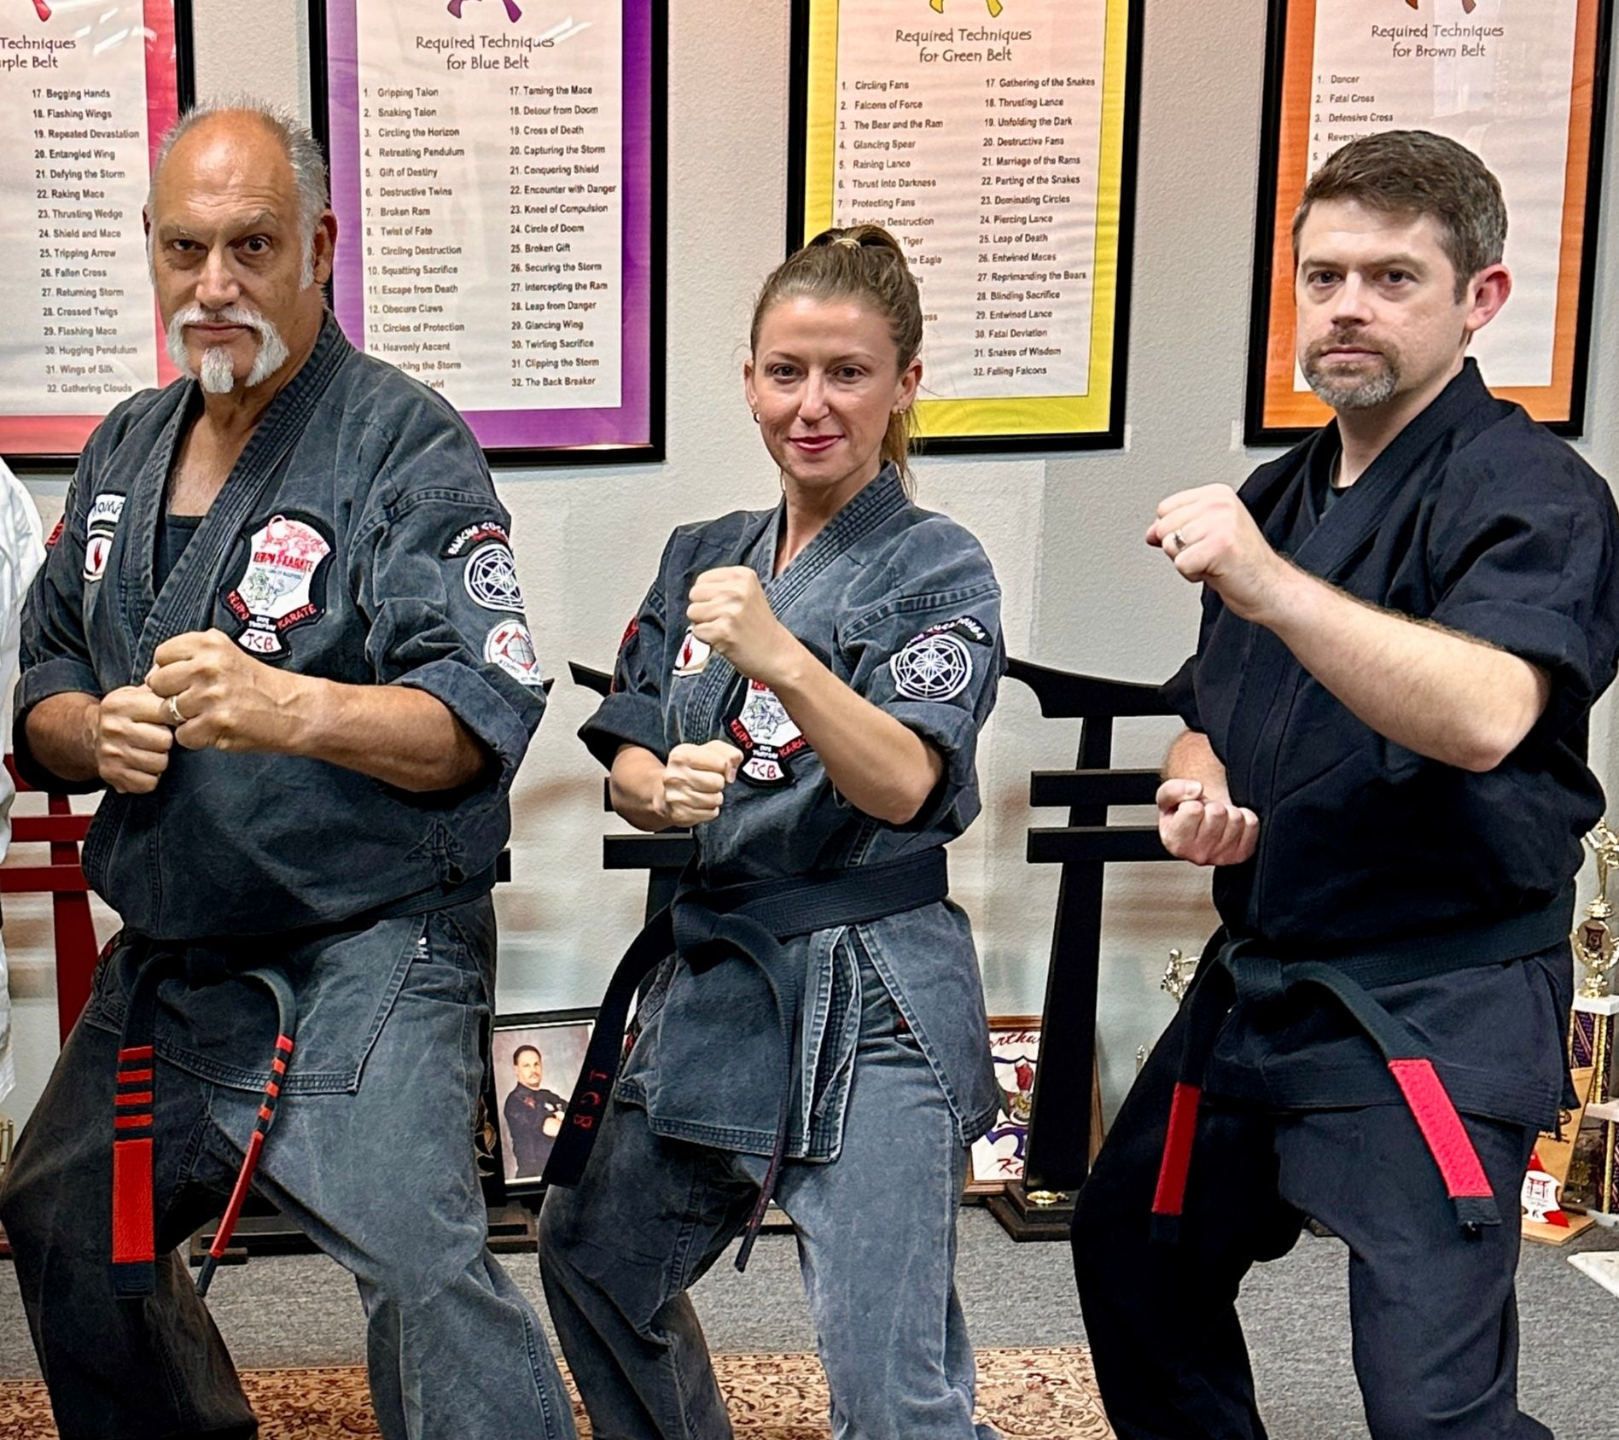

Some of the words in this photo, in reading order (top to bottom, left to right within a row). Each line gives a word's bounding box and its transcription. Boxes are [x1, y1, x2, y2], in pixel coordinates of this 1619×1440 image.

[896, 28, 954, 46] Required
[958, 26, 1032, 45] Techniques
[1371, 24, 1428, 40] Required
[1432, 23, 1504, 40] Techniques
[0, 35, 76, 52] Techniques
[416, 35, 475, 54] Required
[480, 34, 555, 51] Techniques
[919, 47, 938, 62] for
[942, 49, 982, 62] Green
[986, 47, 1012, 61] Belt
[1392, 42, 1411, 58] for
[1416, 44, 1456, 57] Brown
[1461, 42, 1486, 57] Belt
[32, 56, 58, 68] Belt
[446, 54, 467, 71] for
[471, 56, 500, 70] Blue
[503, 55, 530, 69] Belt
[999, 78, 1040, 89] Gathering
[1041, 78, 1050, 86] of
[1051, 78, 1064, 86] the
[1066, 77, 1095, 86] Snakes
[1331, 74, 1360, 84] Dancer
[523, 86, 554, 97] Taming
[556, 86, 569, 94] the
[571, 85, 592, 94] Mace
[855, 81, 887, 92] Circling
[889, 80, 909, 89] Fans
[46, 89, 82, 100] Begging
[84, 89, 111, 98] Hands
[1330, 94, 1350, 103] Fatal
[1351, 94, 1375, 102] Cross
[855, 100, 887, 109] Falcons
[889, 100, 898, 109] of
[899, 100, 923, 109] Force
[998, 98, 1038, 109] Thrusting
[1040, 98, 1064, 106] Lance
[47, 109, 84, 120] Flashing
[85, 109, 112, 120] Wings
[378, 108, 412, 119] Snaking
[414, 107, 437, 116] Talon
[524, 106, 552, 115] Detour
[553, 106, 572, 114] from
[574, 105, 598, 114] Doom
[1329, 113, 1368, 122] Defensive
[1370, 112, 1393, 122] Cross
[524, 126, 548, 135] Cross
[550, 126, 558, 134] of
[560, 125, 584, 134] Death
[854, 120, 870, 130] The
[872, 120, 891, 129] Bear
[892, 120, 908, 129] and
[910, 120, 923, 128] the
[925, 119, 943, 128] Ram
[48, 129, 88, 140] Repeated
[90, 129, 140, 138] Devastation
[378, 128, 411, 139] Circling
[412, 128, 426, 136] the
[428, 127, 460, 136] Horizon
[49, 149, 92, 161] Entangled
[94, 150, 115, 160] Wing
[379, 148, 421, 159] Retreating
[423, 147, 465, 156] Pendulum
[524, 145, 564, 157] Capturing
[566, 145, 579, 154] the
[581, 144, 606, 154] Storm
[996, 157, 1032, 168] Marriage
[1033, 156, 1042, 165] of
[1043, 156, 1056, 164] the
[1058, 155, 1081, 164] Rams
[50, 169, 82, 180] Defying
[84, 169, 98, 178] the
[100, 169, 125, 178] Storm
[379, 168, 395, 177] Gift
[396, 168, 405, 177] of
[407, 167, 438, 178] Destiny
[524, 165, 572, 177] Conquering
[574, 164, 599, 174] Shield
[852, 179, 879, 188] Thrust
[881, 179, 897, 188] into
[898, 178, 936, 187] Darkness
[996, 176, 1024, 187] Parting
[1026, 176, 1035, 184] of
[1036, 176, 1049, 184] the
[1051, 175, 1080, 184] Snakes
[51, 189, 80, 200] Raking
[82, 189, 105, 198] Mace
[380, 187, 426, 197] Destructive
[428, 187, 452, 196] Twins
[524, 185, 566, 194] Encounter
[568, 185, 585, 193] with
[587, 184, 616, 195] Danger
[852, 198, 894, 210] Protecting
[896, 198, 916, 207] Fans
[994, 195, 1041, 206] Dominating
[1042, 194, 1070, 203] Circles
[52, 209, 93, 220] Thrusting
[94, 209, 123, 220] Wedge
[525, 205, 548, 214] Kneel
[549, 204, 558, 213] of
[560, 204, 608, 214] Compulsion
[53, 229, 80, 238] Shield
[82, 229, 97, 238] and
[100, 229, 121, 237] Mace
[54, 249, 89, 260] Tripping
[91, 249, 116, 257] Arrow
[55, 268, 80, 277] Fallen
[82, 268, 107, 277] Cross
[525, 263, 561, 274] Securing
[563, 263, 576, 271] the
[578, 262, 602, 271] Storm
[56, 288, 97, 298] Returning
[99, 287, 124, 296] Storm
[57, 307, 92, 316] Crossed
[94, 307, 118, 318] Twigs
[525, 358, 559, 370] Clipping
[560, 358, 574, 367] the
[575, 357, 599, 366] Storm
[525, 378, 541, 386] The
[543, 377, 563, 386] Back
[565, 376, 596, 385] Breaker
[277, 604, 317, 630] KARATE
[246, 633, 274, 651] TCB
[751, 762, 776, 779] TCB
